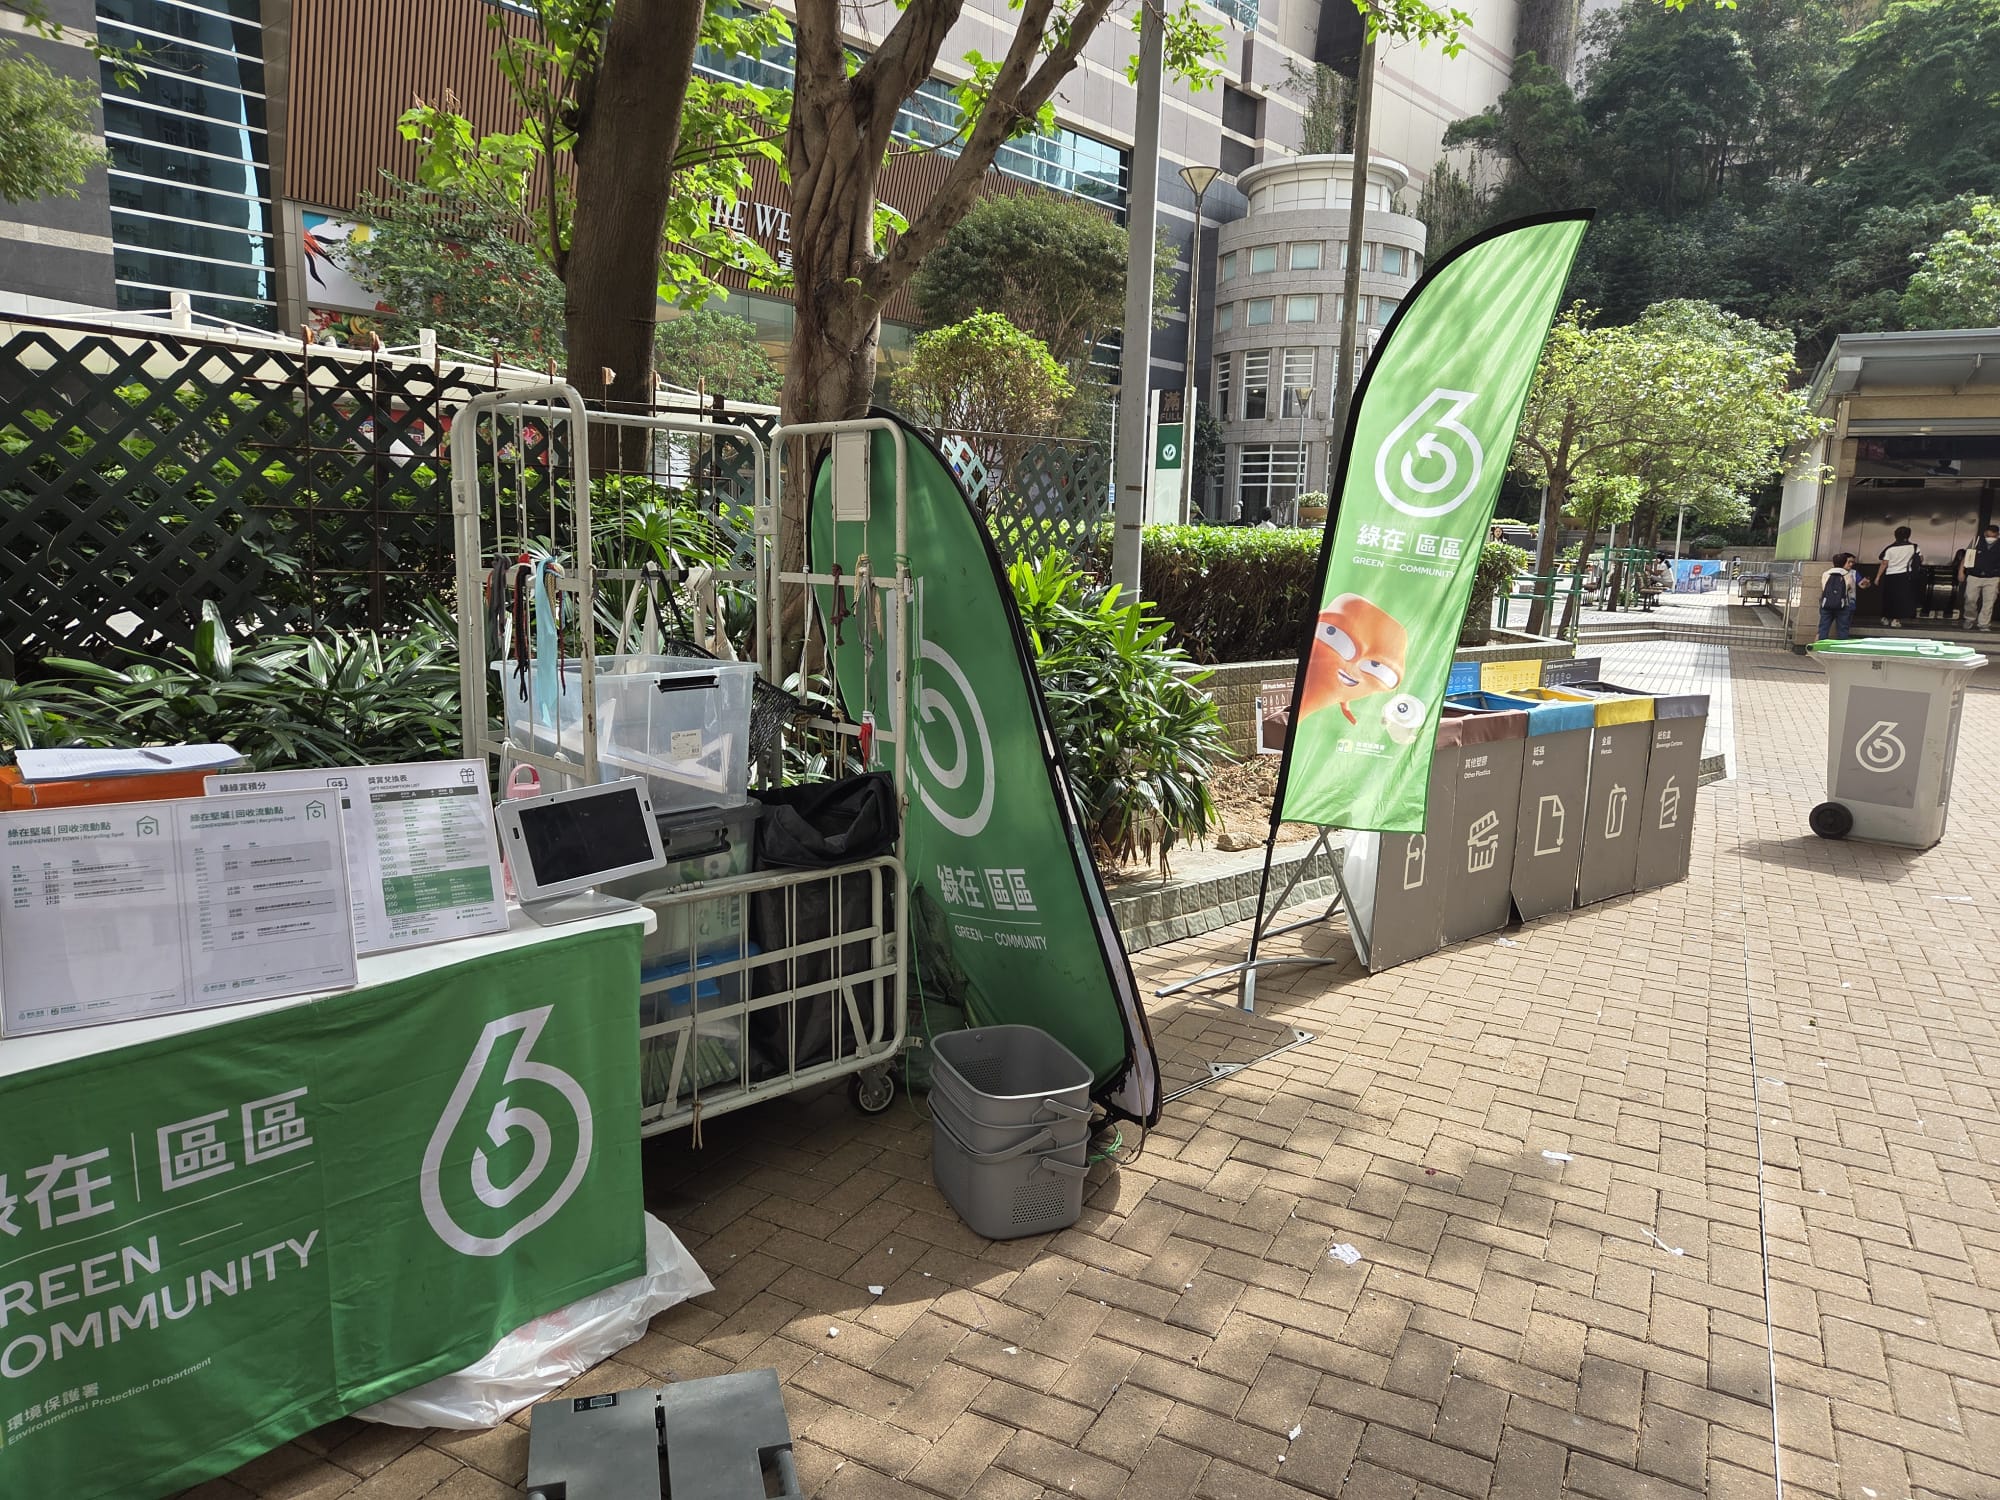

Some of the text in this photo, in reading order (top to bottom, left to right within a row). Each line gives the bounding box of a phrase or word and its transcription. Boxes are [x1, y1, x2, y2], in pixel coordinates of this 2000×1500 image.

[754, 203, 791, 243] WE
[1160, 412, 1182, 421] FULL
[1356, 523, 1464, 561] 綠在 區區
[1352, 556, 1456, 579] GREEN COMMUNITY
[1463, 772, 1475, 780] Other
[57, 821, 112, 834] 回收流動點
[937, 863, 1038, 911] 綠在 區區
[955, 924, 1048, 950] GREEN COMMUNITY
[157, 1086, 313, 1192] 區區
[0, 1235, 161, 1328] REEN
[0, 1229, 320, 1379] OMMUNITY
[7, 1382, 100, 1432] 環境保護署
[8, 1356, 212, 1446] Environmental Protection Department
